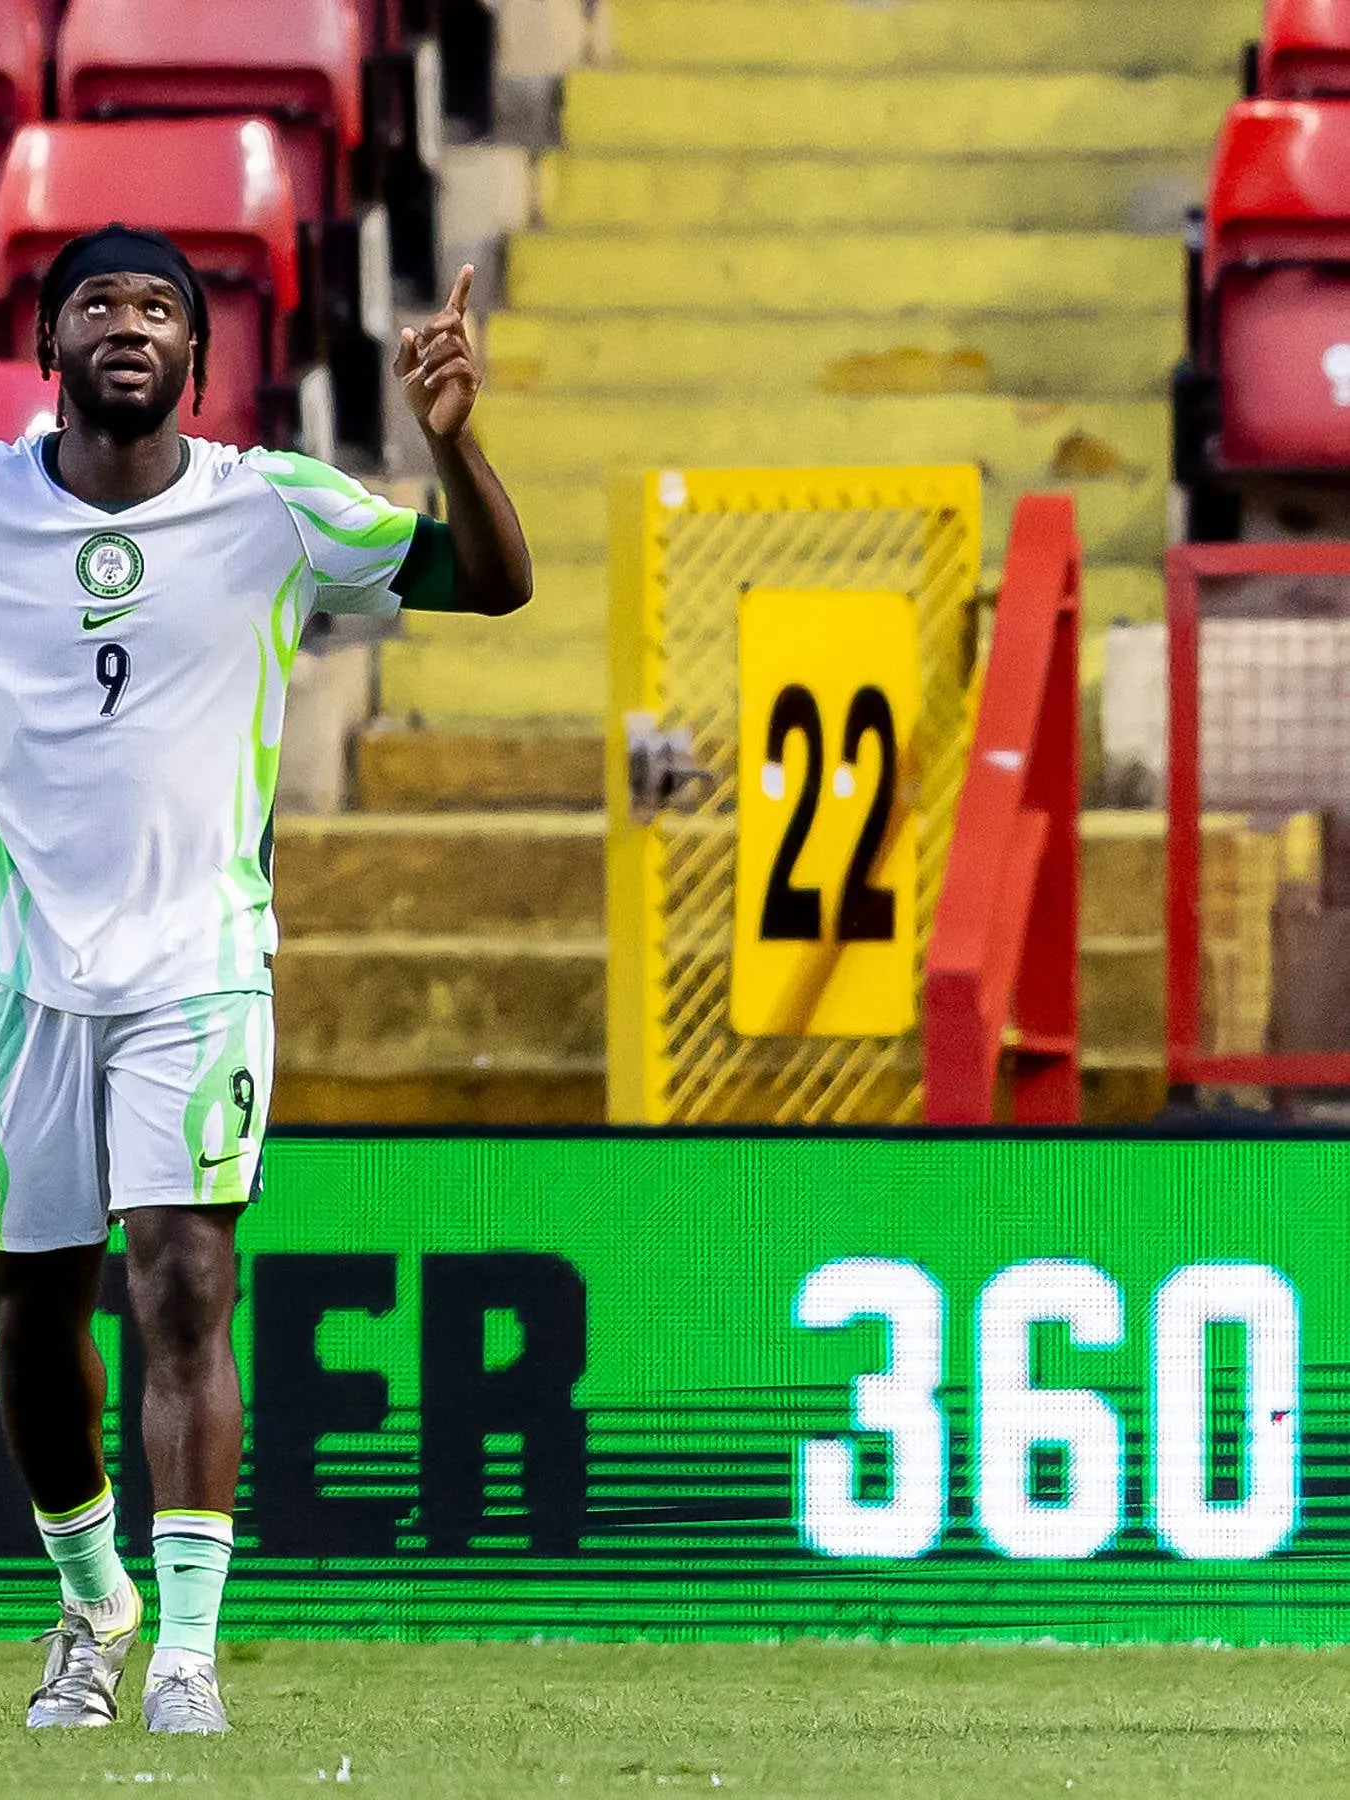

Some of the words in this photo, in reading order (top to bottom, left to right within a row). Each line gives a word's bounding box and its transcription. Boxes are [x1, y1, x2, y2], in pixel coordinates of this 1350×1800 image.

[96, 643, 131, 717] 9
[759, 683, 896, 941] 22
[229, 1065, 254, 1138] 9
[793, 1256, 1299, 1558] 360
